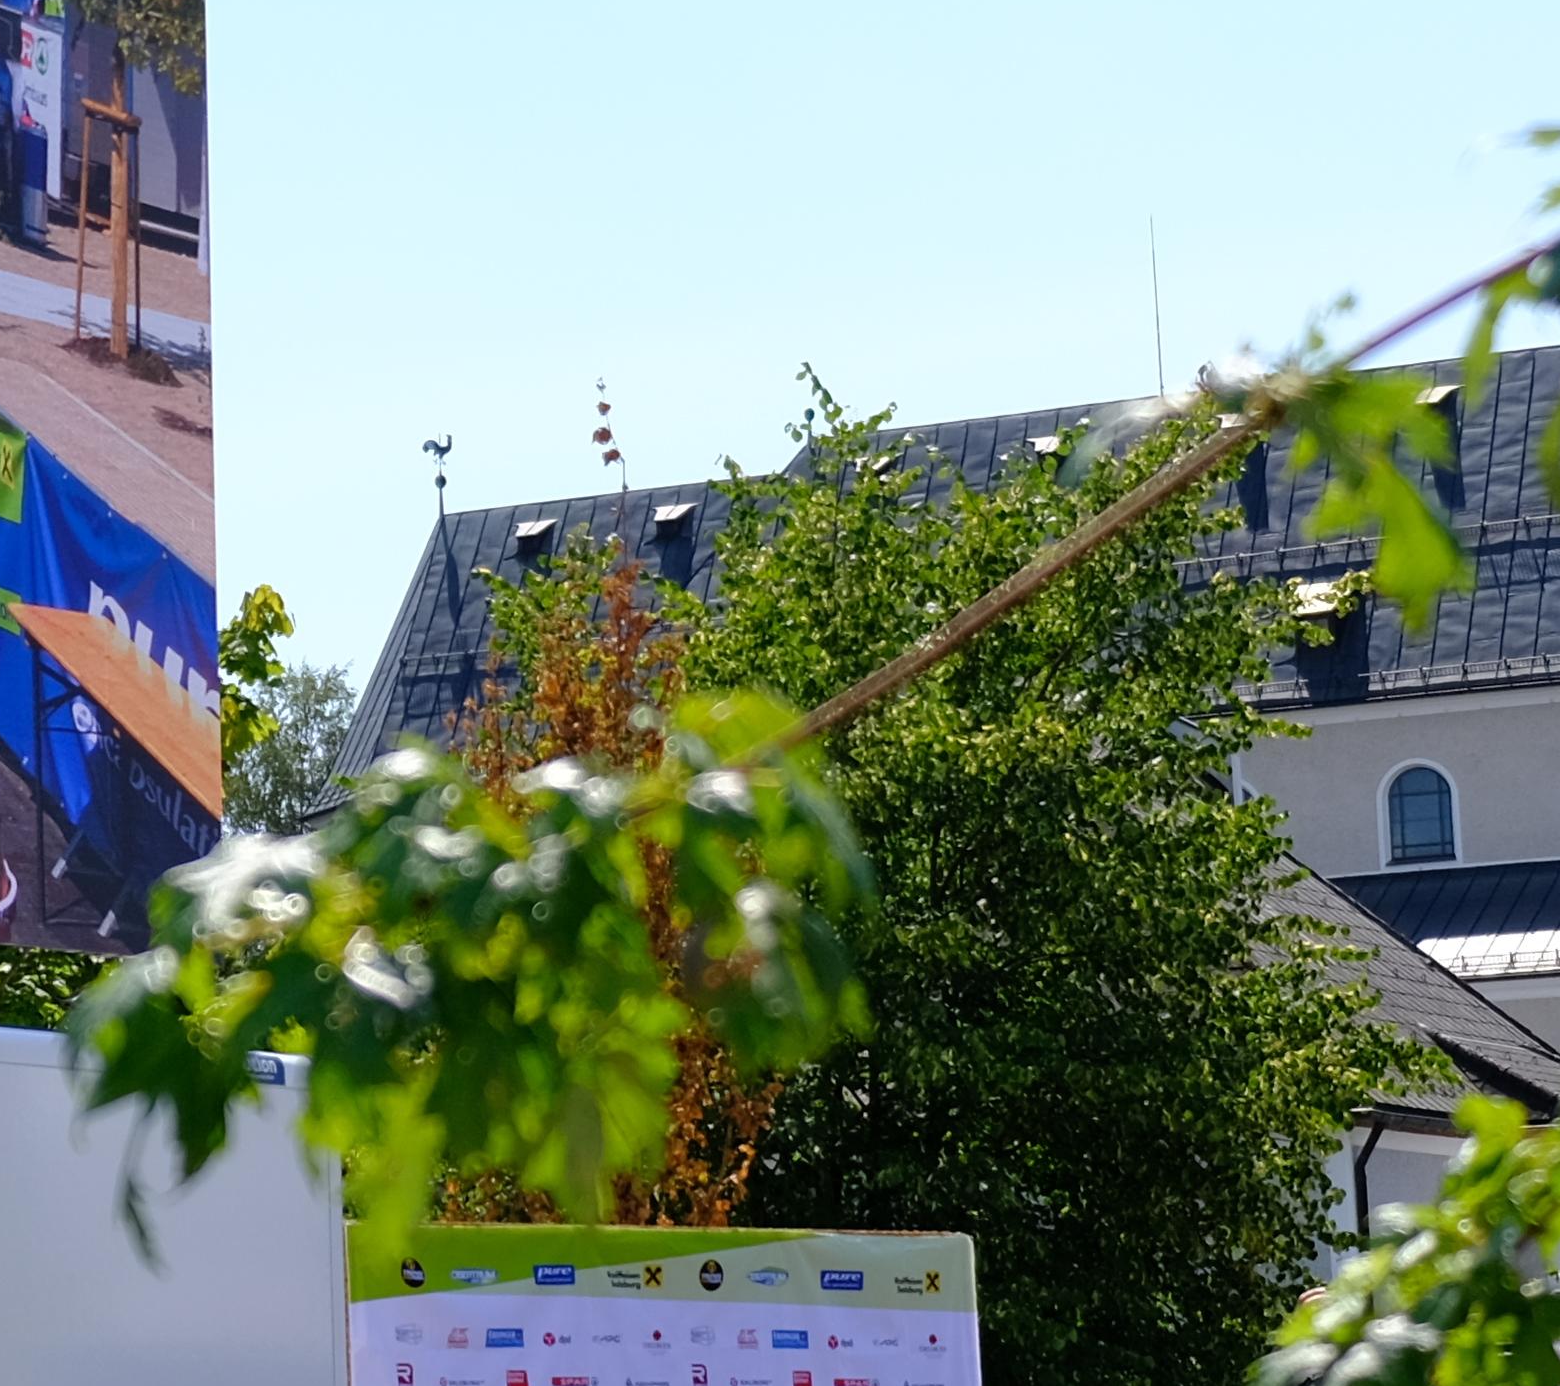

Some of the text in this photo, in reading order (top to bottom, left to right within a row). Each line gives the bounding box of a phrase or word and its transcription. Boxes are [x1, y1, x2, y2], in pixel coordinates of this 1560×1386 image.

[536, 1265, 573, 1279] pure
[824, 1271, 862, 1284] pure
[560, 1377, 589, 1386] SPAR
